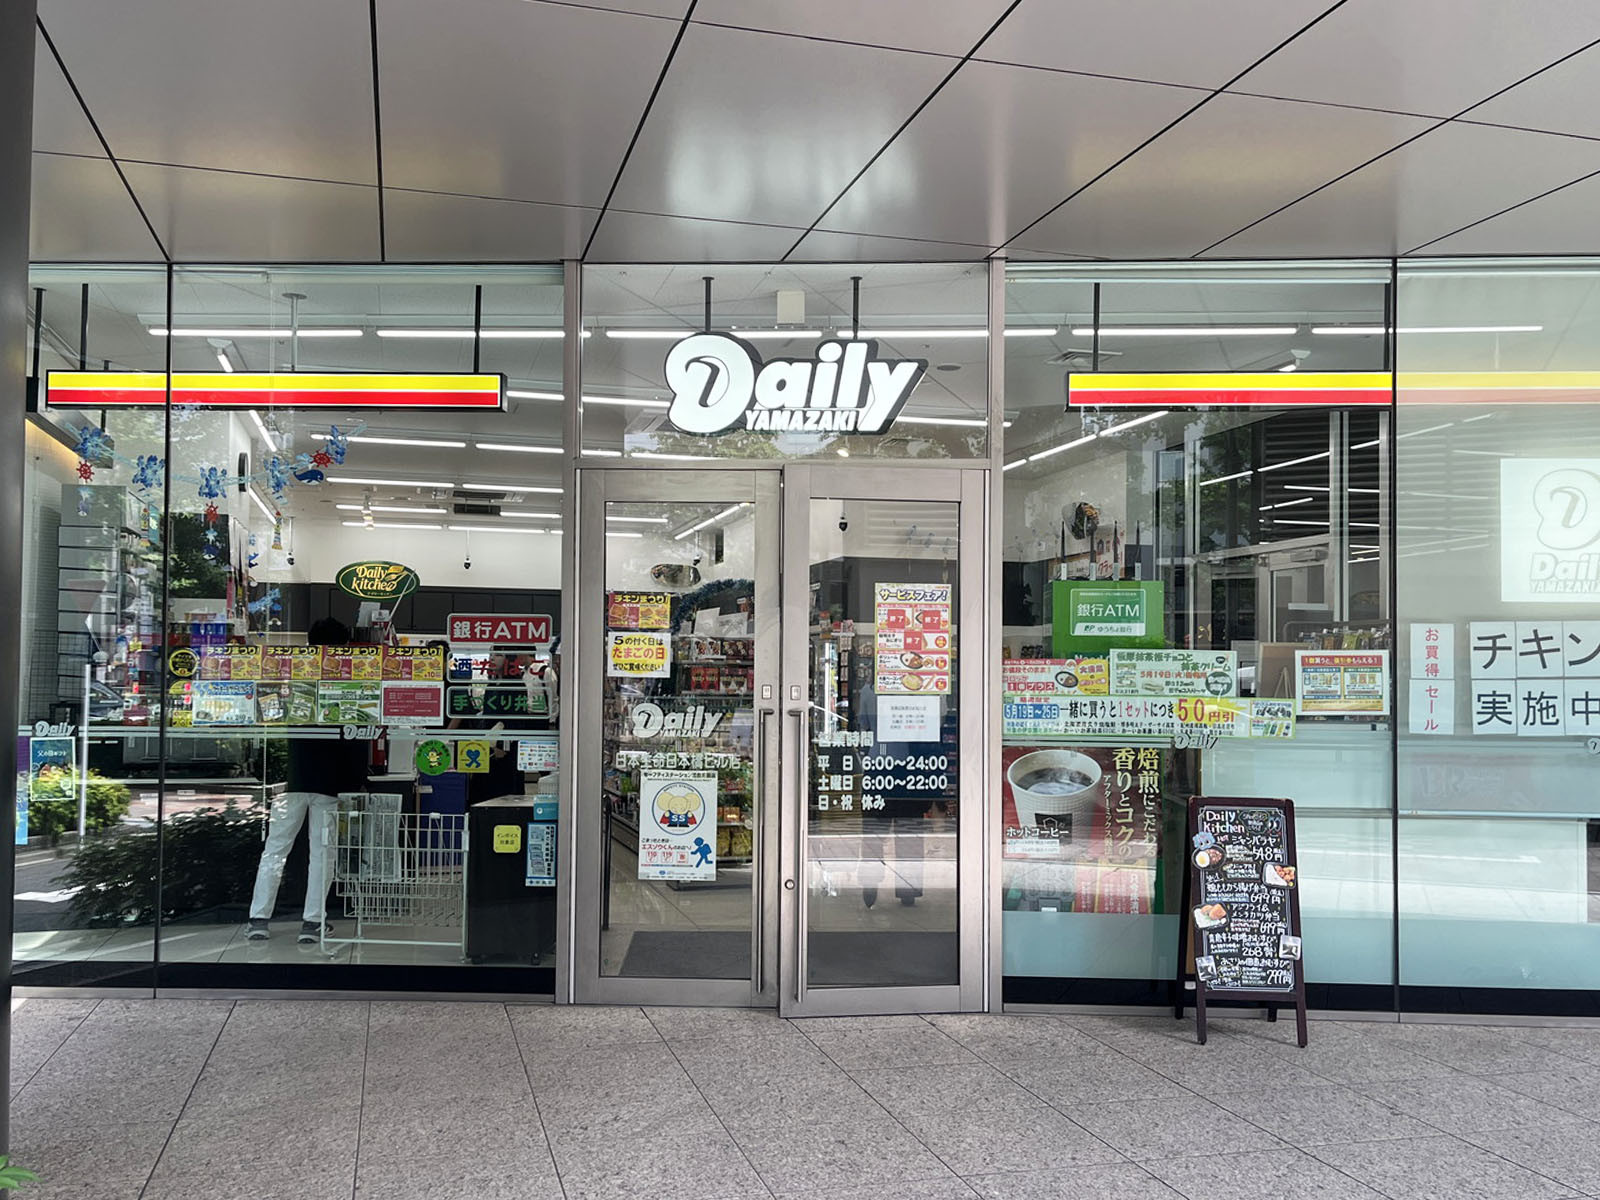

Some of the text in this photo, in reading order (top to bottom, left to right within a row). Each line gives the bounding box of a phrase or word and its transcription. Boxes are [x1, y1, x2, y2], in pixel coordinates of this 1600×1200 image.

[664, 333, 921, 433] Daily
[745, 409, 857, 431] YAMAZAKI
[355, 566, 387, 580] Daily
[1530, 552, 1600, 580] Dail
[351, 577, 397, 592] kitchen
[879, 588, 948, 601] サービスフェア!
[1077, 603, 1140, 617] 銀行ATM
[453, 621, 546, 639] 銀行ATM
[613, 635, 663, 646] 5の付く日は
[612, 647, 665, 660] たまごの日
[1473, 629, 1600, 670] チキン
[1424, 627, 1439, 731] お買得 セール
[453, 694, 547, 712] 手づくり弁当
[1476, 690, 1600, 726] 実施中
[35, 720, 75, 737] Daily
[632, 703, 723, 738] Daily
[343, 724, 384, 739] Daily
[817, 731, 874, 747] 営業時間
[616, 752, 741, 769] 日本生命日本橋ビル店
[818, 775, 853, 791] 土曜日
[818, 794, 886, 811] 日・祝 休み
[1112, 748, 1137, 858] 香りとコクの
[1138, 747, 1160, 858] 焙煎にこだわる
[1206, 811, 1236, 822] Daily
[1006, 827, 1069, 838] ホットコーヒー
[1203, 821, 1245, 834] Kitchen
